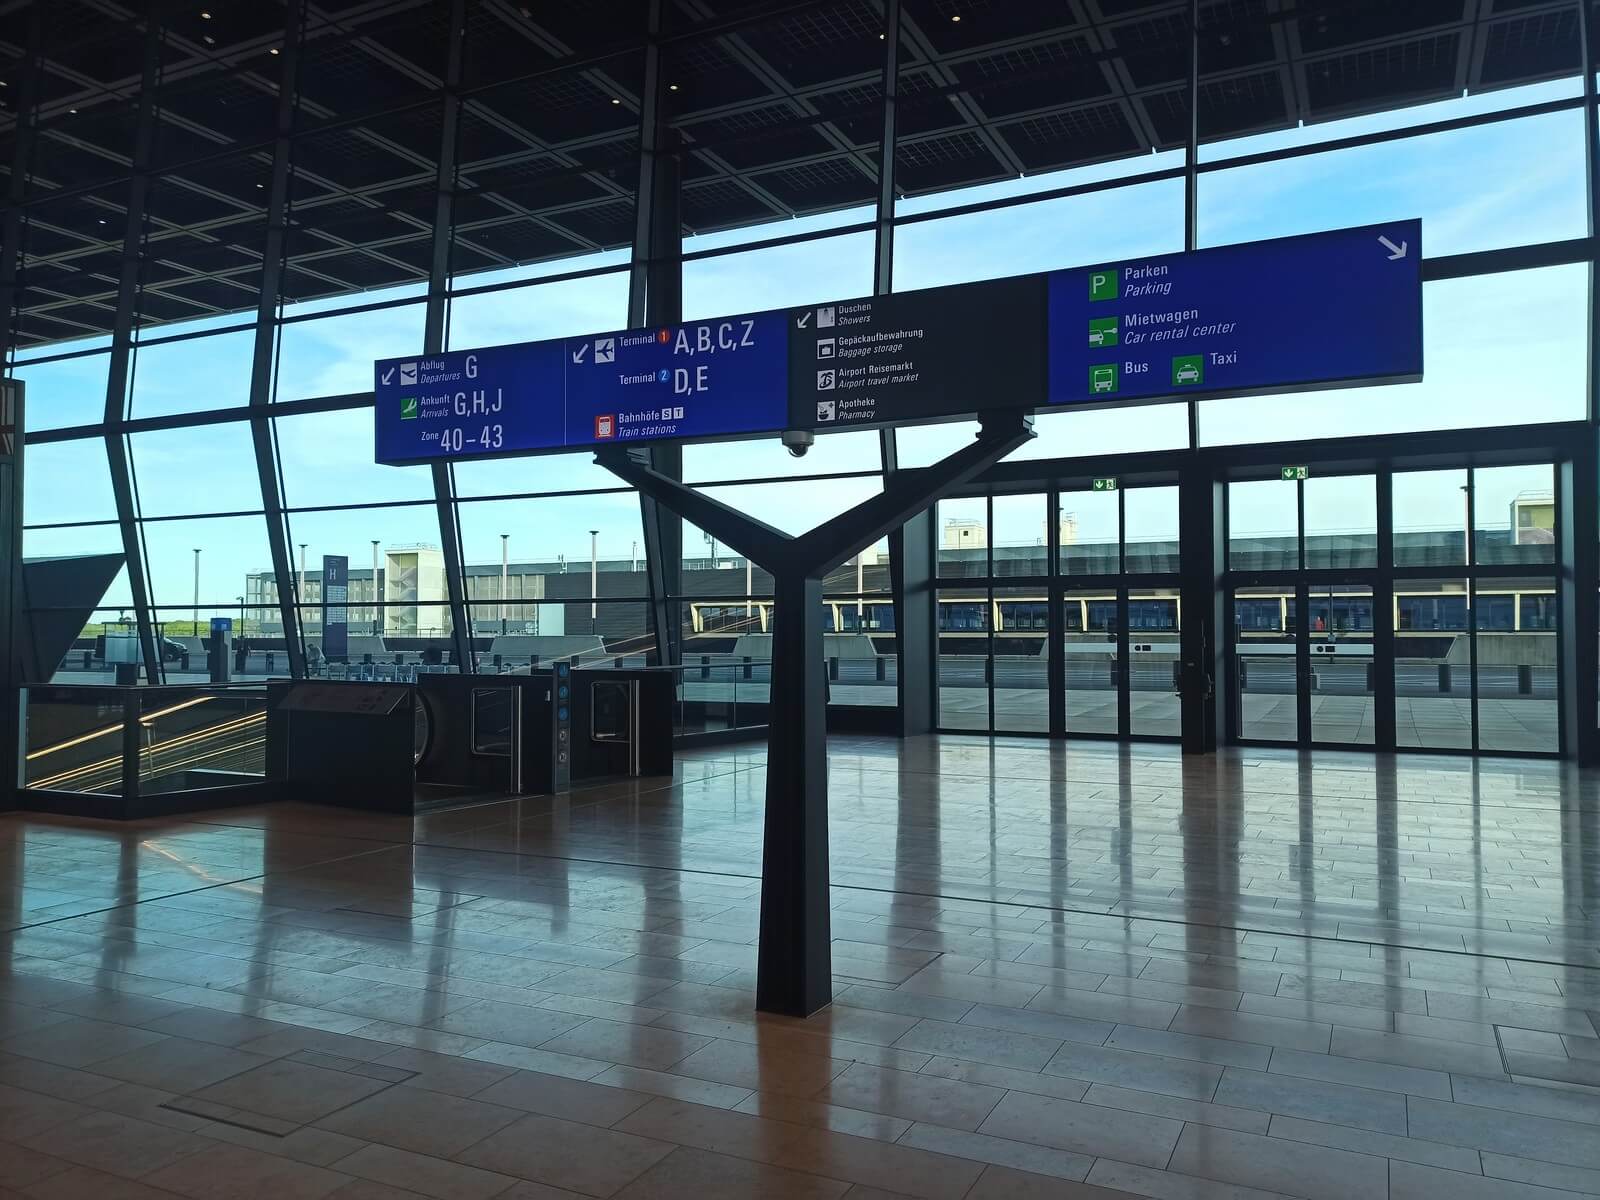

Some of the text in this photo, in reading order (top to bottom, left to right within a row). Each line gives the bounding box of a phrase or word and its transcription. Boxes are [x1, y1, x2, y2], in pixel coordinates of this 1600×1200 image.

[1124, 265, 1169, 281] Parken
[1092, 275, 1106, 294] P
[1124, 281, 1172, 298] Parking
[838, 303, 872, 315] Duschen
[838, 315, 871, 327] Showers
[1124, 309, 1199, 328] Mietwagen
[619, 332, 656, 347] Terminal
[838, 329, 924, 347] Gepäckaufbewahrung
[1124, 321, 1237, 345] Car rental center
[838, 343, 903, 359] Baggage storage
[1209, 350, 1238, 366] Taxi
[420, 354, 478, 379] Abflug G
[838, 361, 914, 378] Airport Reisemarkt
[1124, 361, 1149, 375] Bus
[420, 372, 461, 385] Departures
[619, 371, 656, 385] Terminal
[838, 373, 919, 390] Airport travel market
[420, 393, 450, 406] Ankunft
[838, 397, 876, 410] Apotheke
[420, 407, 449, 419] Arrivals
[618, 410, 660, 424] Bahnhöfe
[838, 410, 876, 420] Pharmacy
[421, 431, 440, 441] Zone
[618, 424, 677, 438] Train stations
